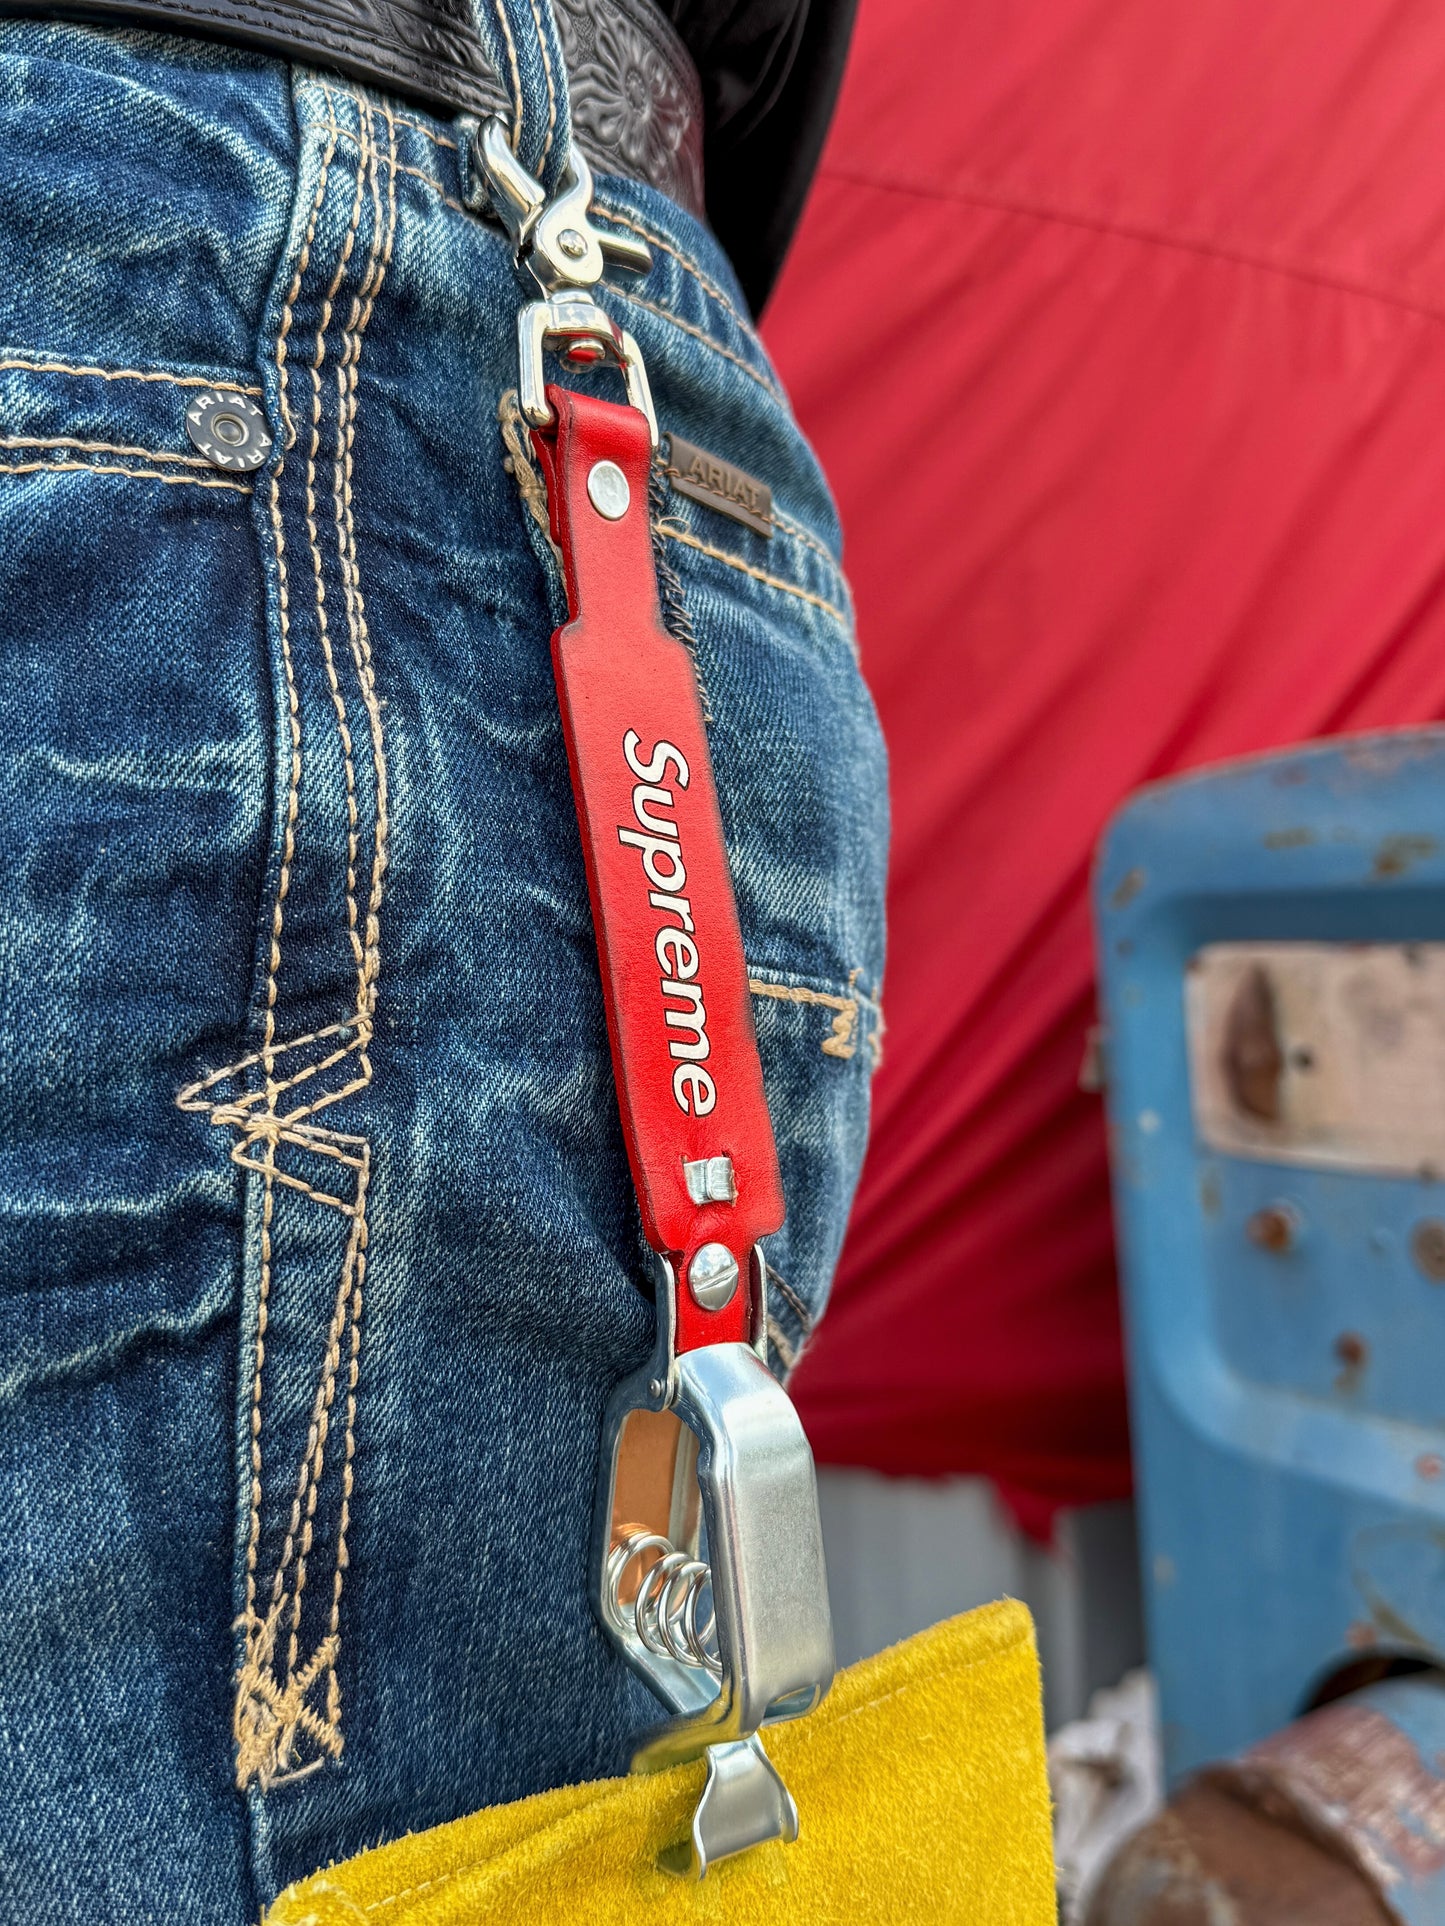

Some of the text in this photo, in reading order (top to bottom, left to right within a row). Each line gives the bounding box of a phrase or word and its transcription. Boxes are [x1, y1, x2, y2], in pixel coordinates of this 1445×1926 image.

[188, 392, 263, 426] ARIAT
[198, 432, 272, 468] ARIAT
[689, 456, 759, 506] ARIAT
[617, 728, 717, 1117] Supreme
